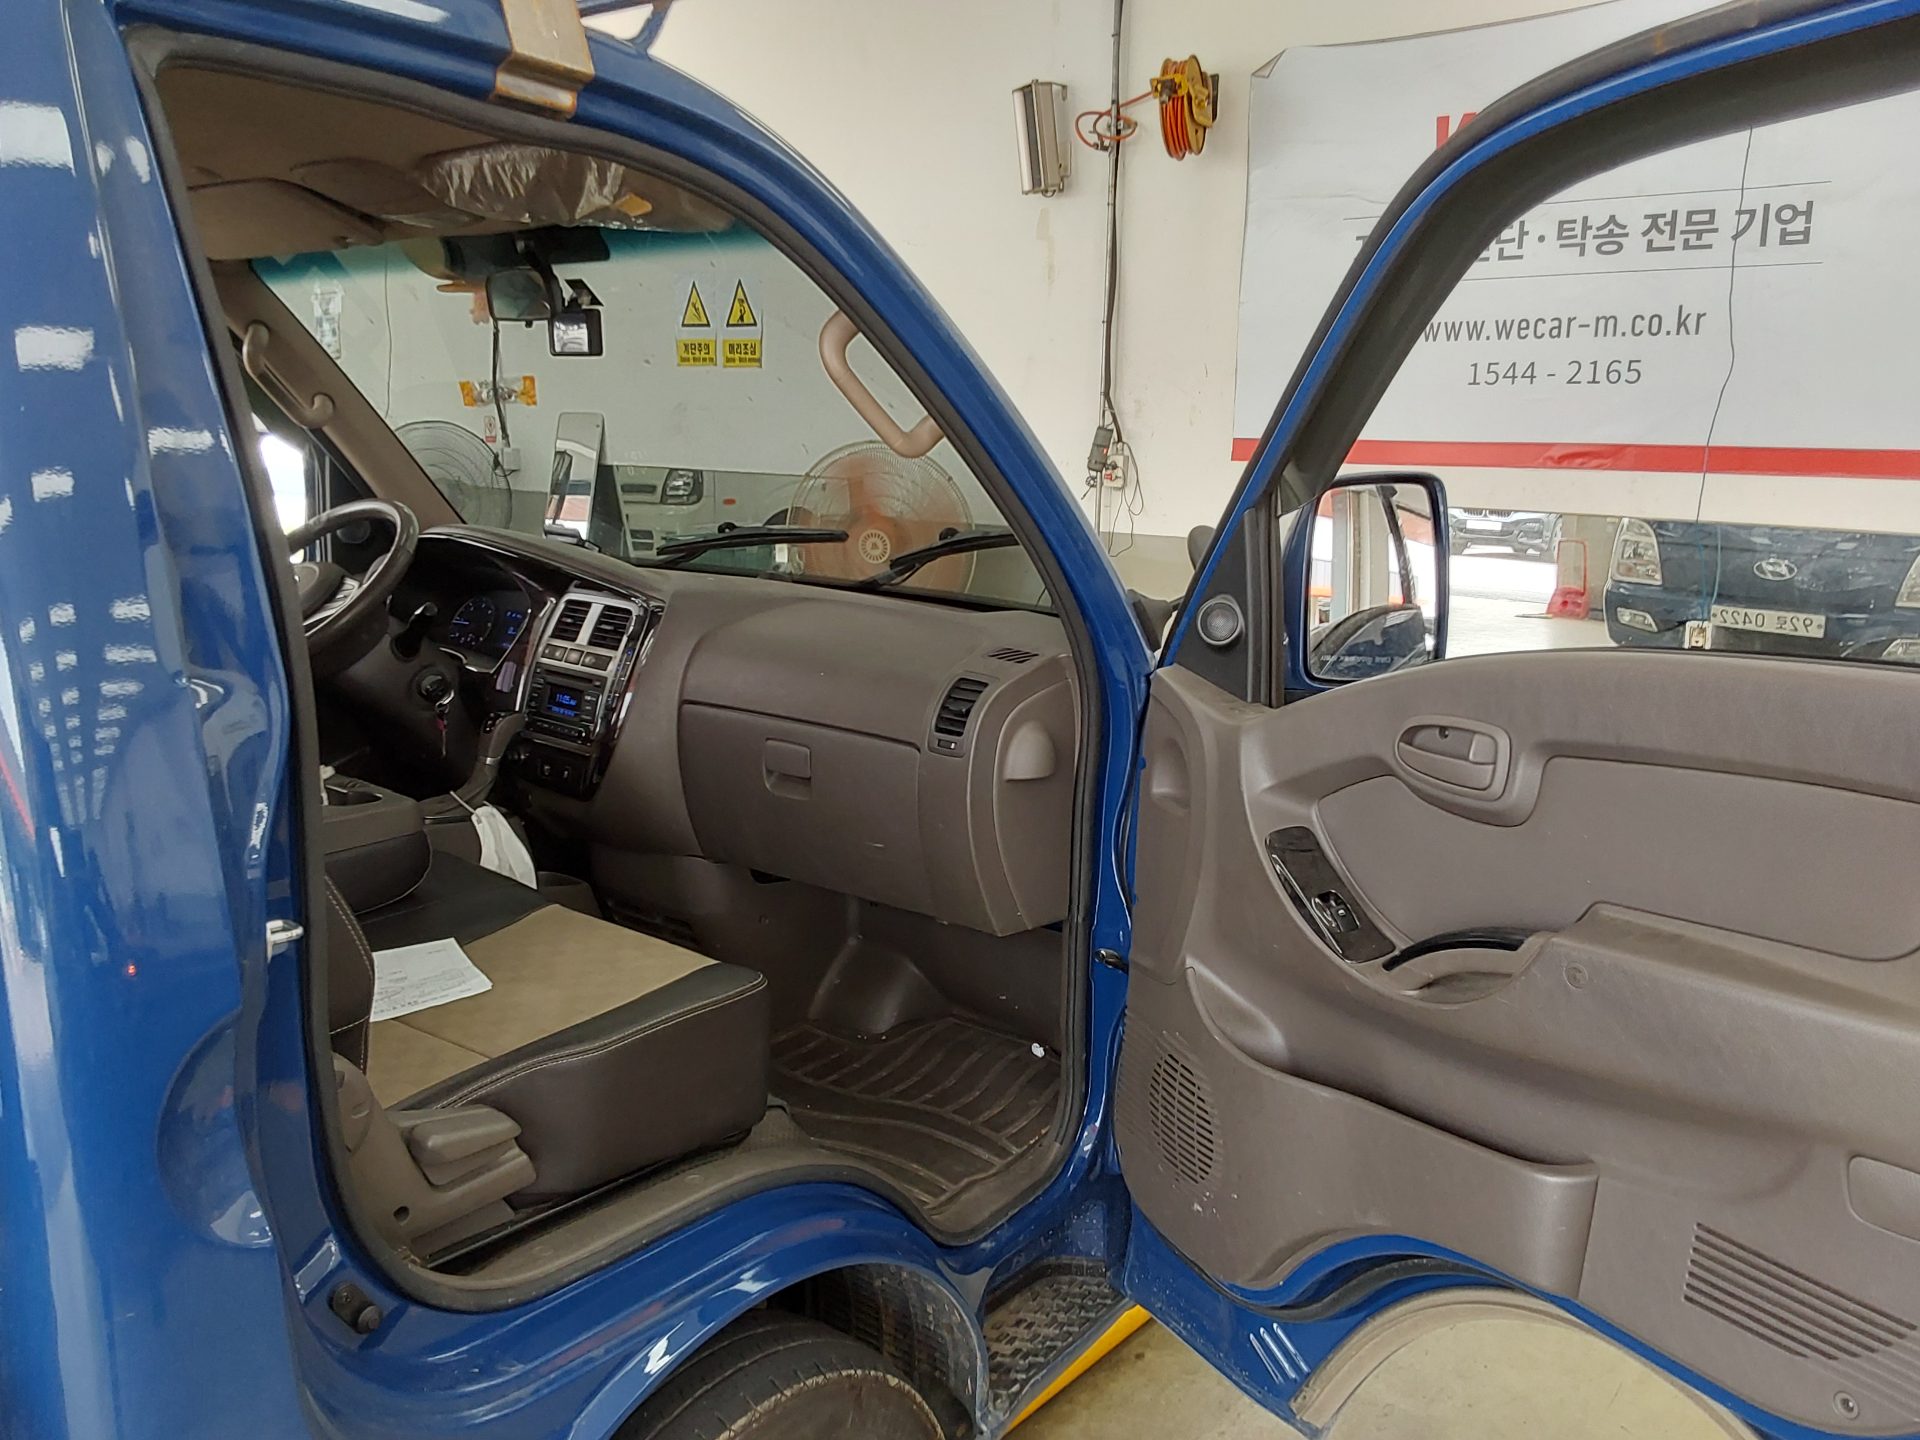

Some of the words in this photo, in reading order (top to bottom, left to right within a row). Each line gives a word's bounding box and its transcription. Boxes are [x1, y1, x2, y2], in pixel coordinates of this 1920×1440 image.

[1477, 214, 1629, 263] 단·탁송
[1640, 208, 1719, 254] 전문
[1731, 200, 1815, 247] 기업
[1423, 304, 1707, 342] www.wecar-m.co.kr
[728, 343, 757, 356] 머리조심
[1467, 361, 1537, 386] 1544
[1566, 359, 1643, 385] 2165
